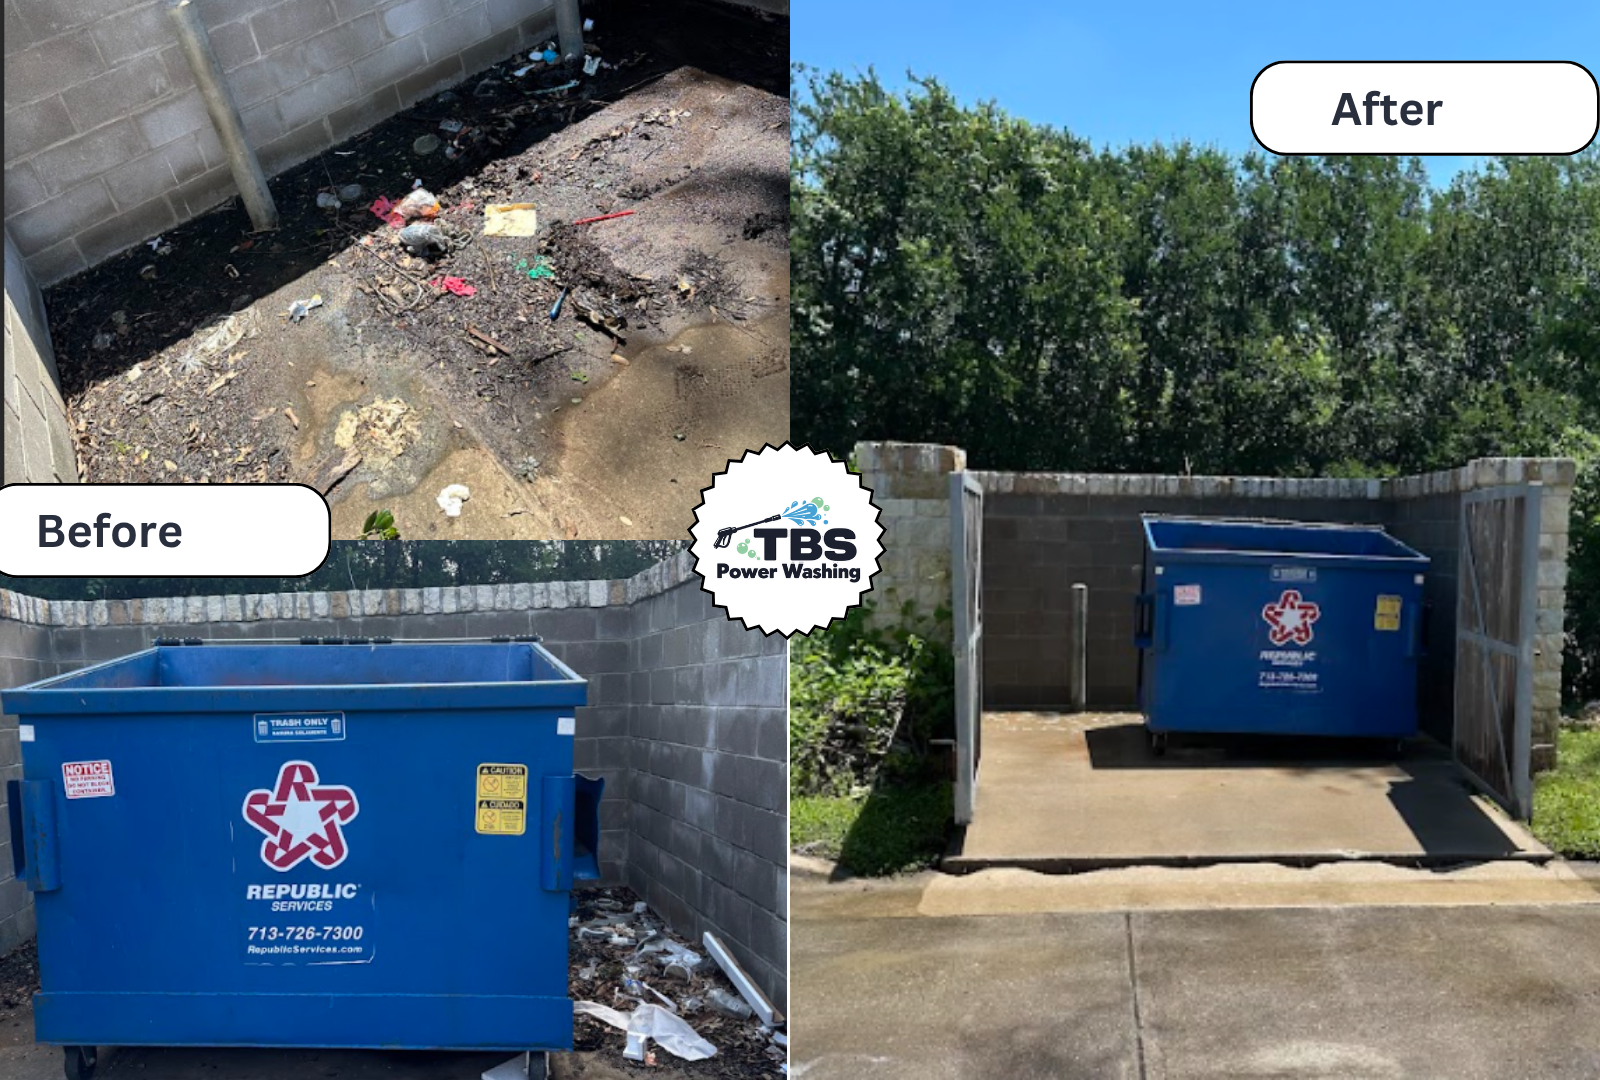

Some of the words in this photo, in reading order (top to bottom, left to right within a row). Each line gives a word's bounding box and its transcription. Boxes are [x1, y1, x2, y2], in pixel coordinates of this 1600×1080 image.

[269, 718, 302, 727] TRASH
[303, 718, 329, 726] ONLY
[65, 763, 109, 776] NOTICE
[490, 767, 523, 775] CAUTION
[247, 883, 358, 900] REPUBLIC
[271, 900, 333, 912] SERVICES
[248, 926, 363, 941] 713-726-7300
[247, 945, 363, 955] RepublicServices.com
